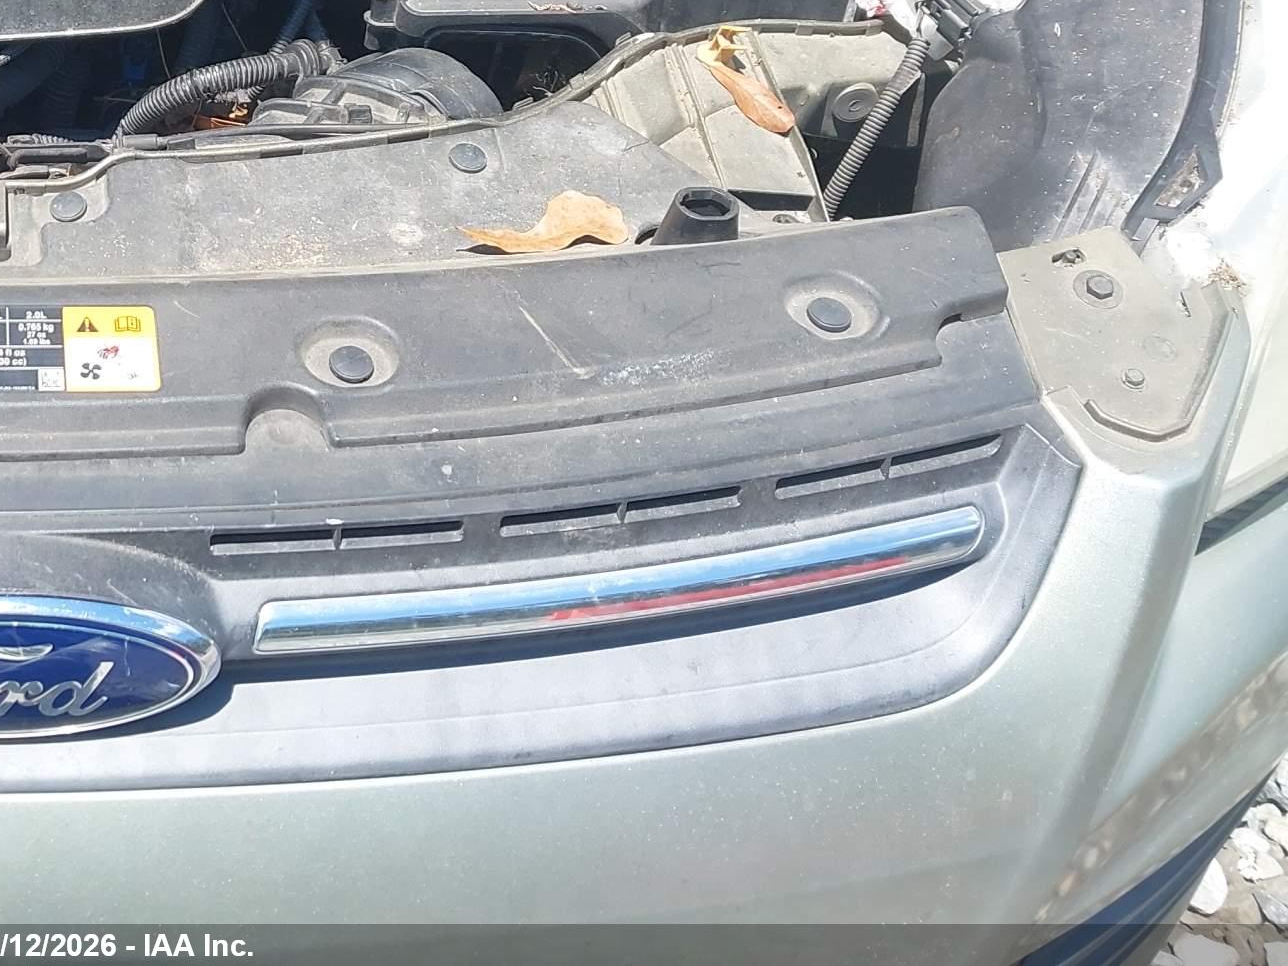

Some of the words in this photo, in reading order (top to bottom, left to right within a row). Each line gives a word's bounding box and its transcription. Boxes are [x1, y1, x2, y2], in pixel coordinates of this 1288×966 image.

[25, 310, 47, 319] 2.0L
[42, 322, 55, 333] kg
[13, 349, 26, 357] oz
[11, 357, 27, 367] cc)
